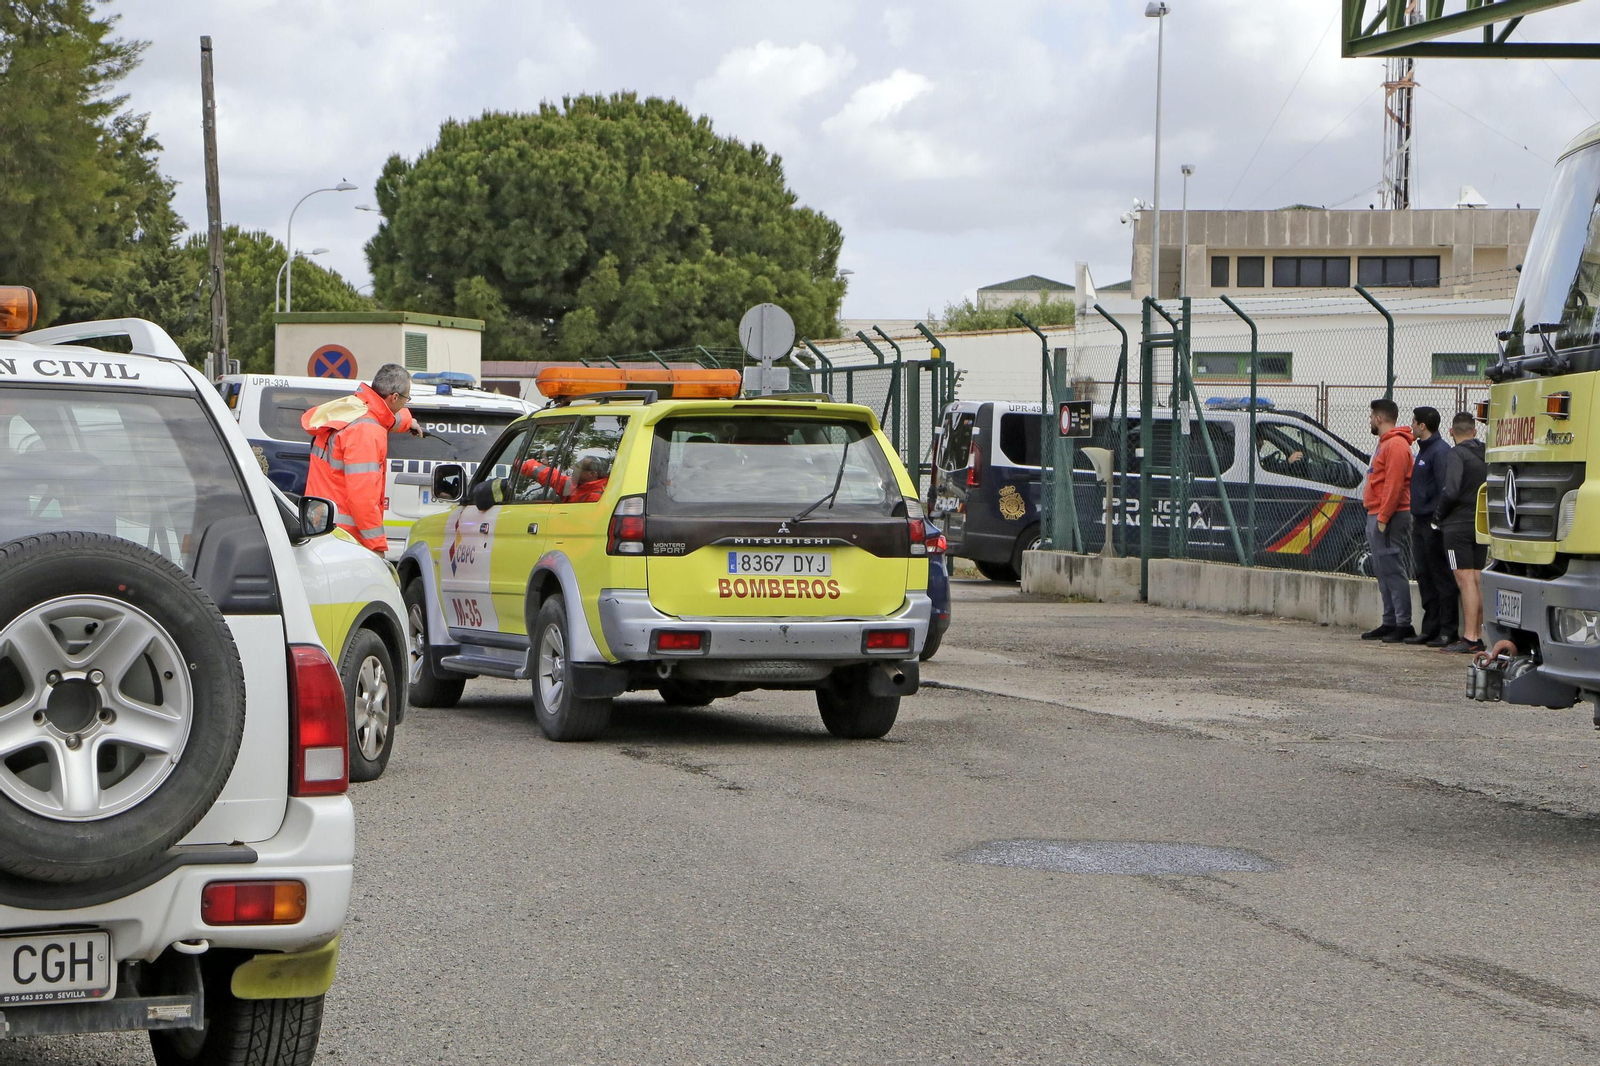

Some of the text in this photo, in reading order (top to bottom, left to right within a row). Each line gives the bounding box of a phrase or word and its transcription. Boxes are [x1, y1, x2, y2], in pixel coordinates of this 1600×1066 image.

[33, 359, 140, 380] CIVIL
[252, 377, 290, 387] UPR-33A
[426, 423, 487, 435] POLICIA
[456, 545, 475, 565] CBPC
[741, 554, 785, 573] 8367
[793, 555, 826, 573] DYJ
[718, 578, 841, 600] BOMBEROS
[452, 598, 483, 627] M-35
[13, 941, 94, 985] CGH
[57, 990, 86, 999] SEVILLA
